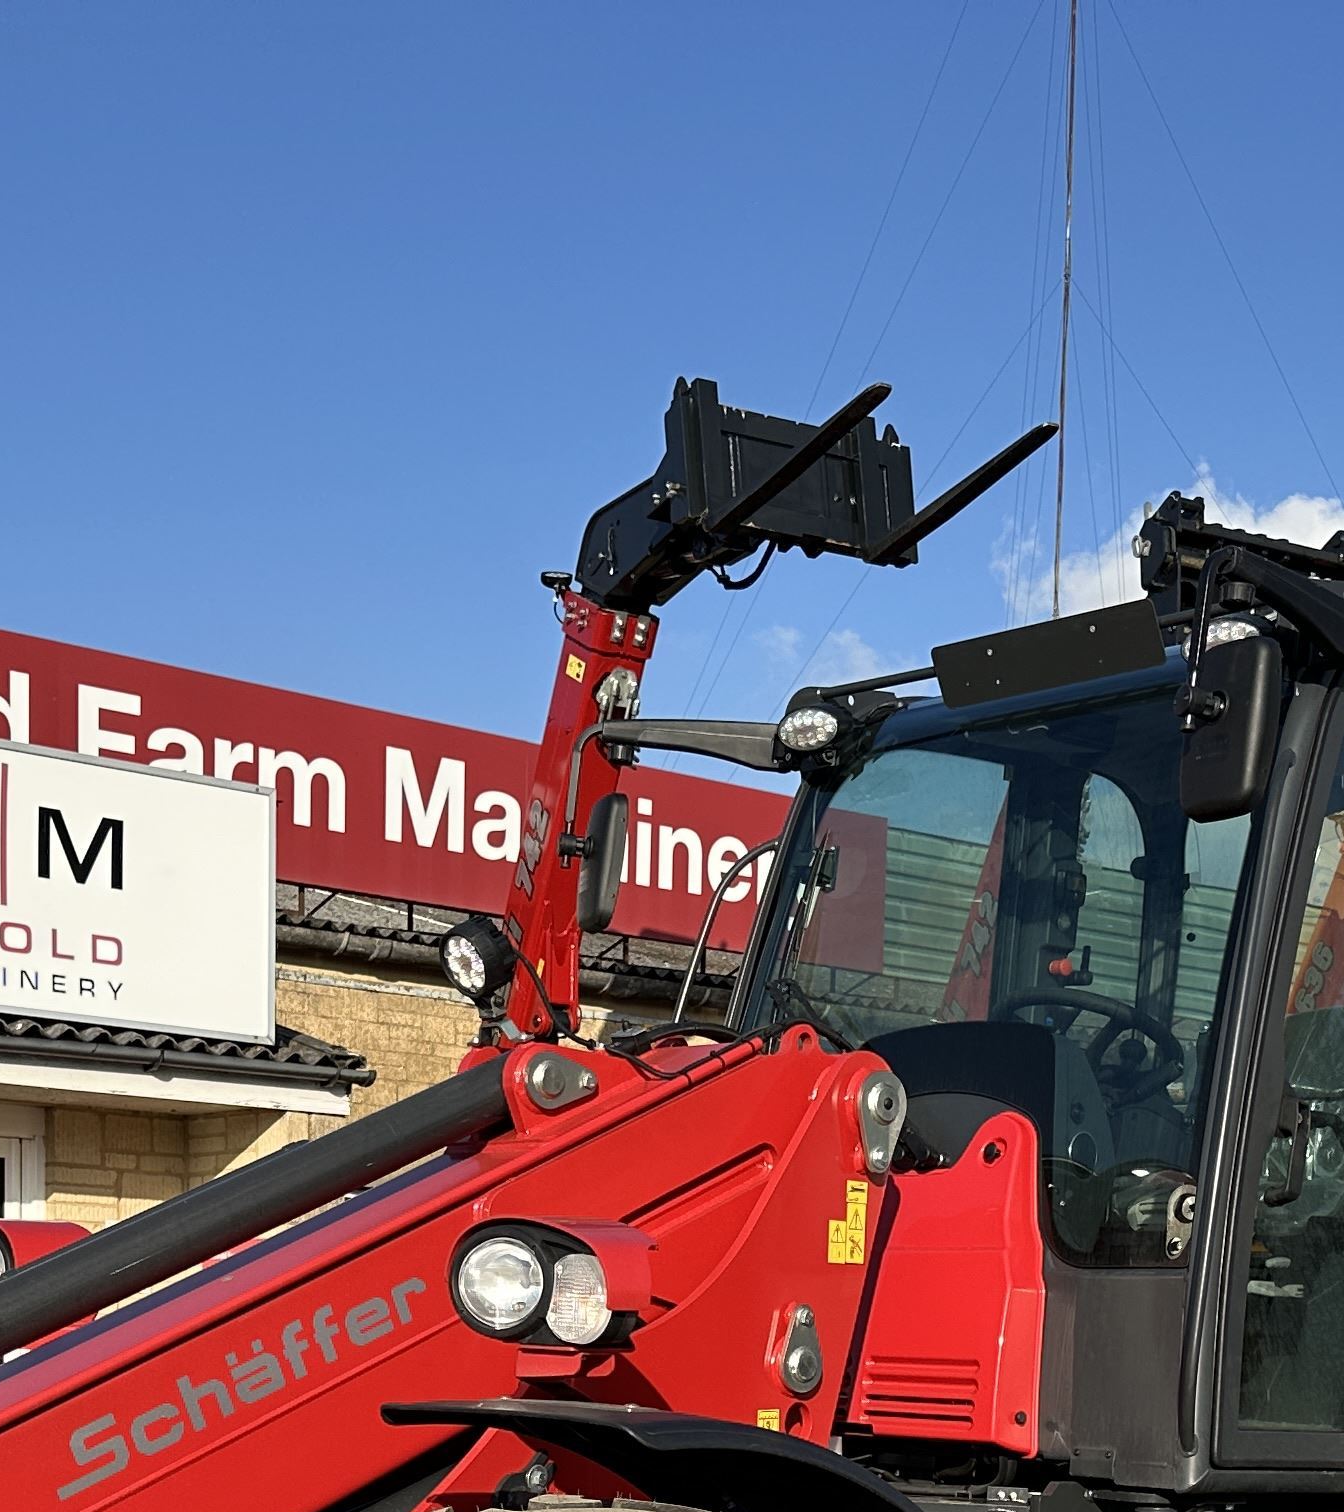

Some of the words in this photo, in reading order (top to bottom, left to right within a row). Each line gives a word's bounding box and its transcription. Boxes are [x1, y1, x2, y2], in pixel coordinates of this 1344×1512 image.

[77, 683, 346, 833] Farm
[514, 798, 551, 900] 742
[57, 1277, 426, 1500] Schäffer
